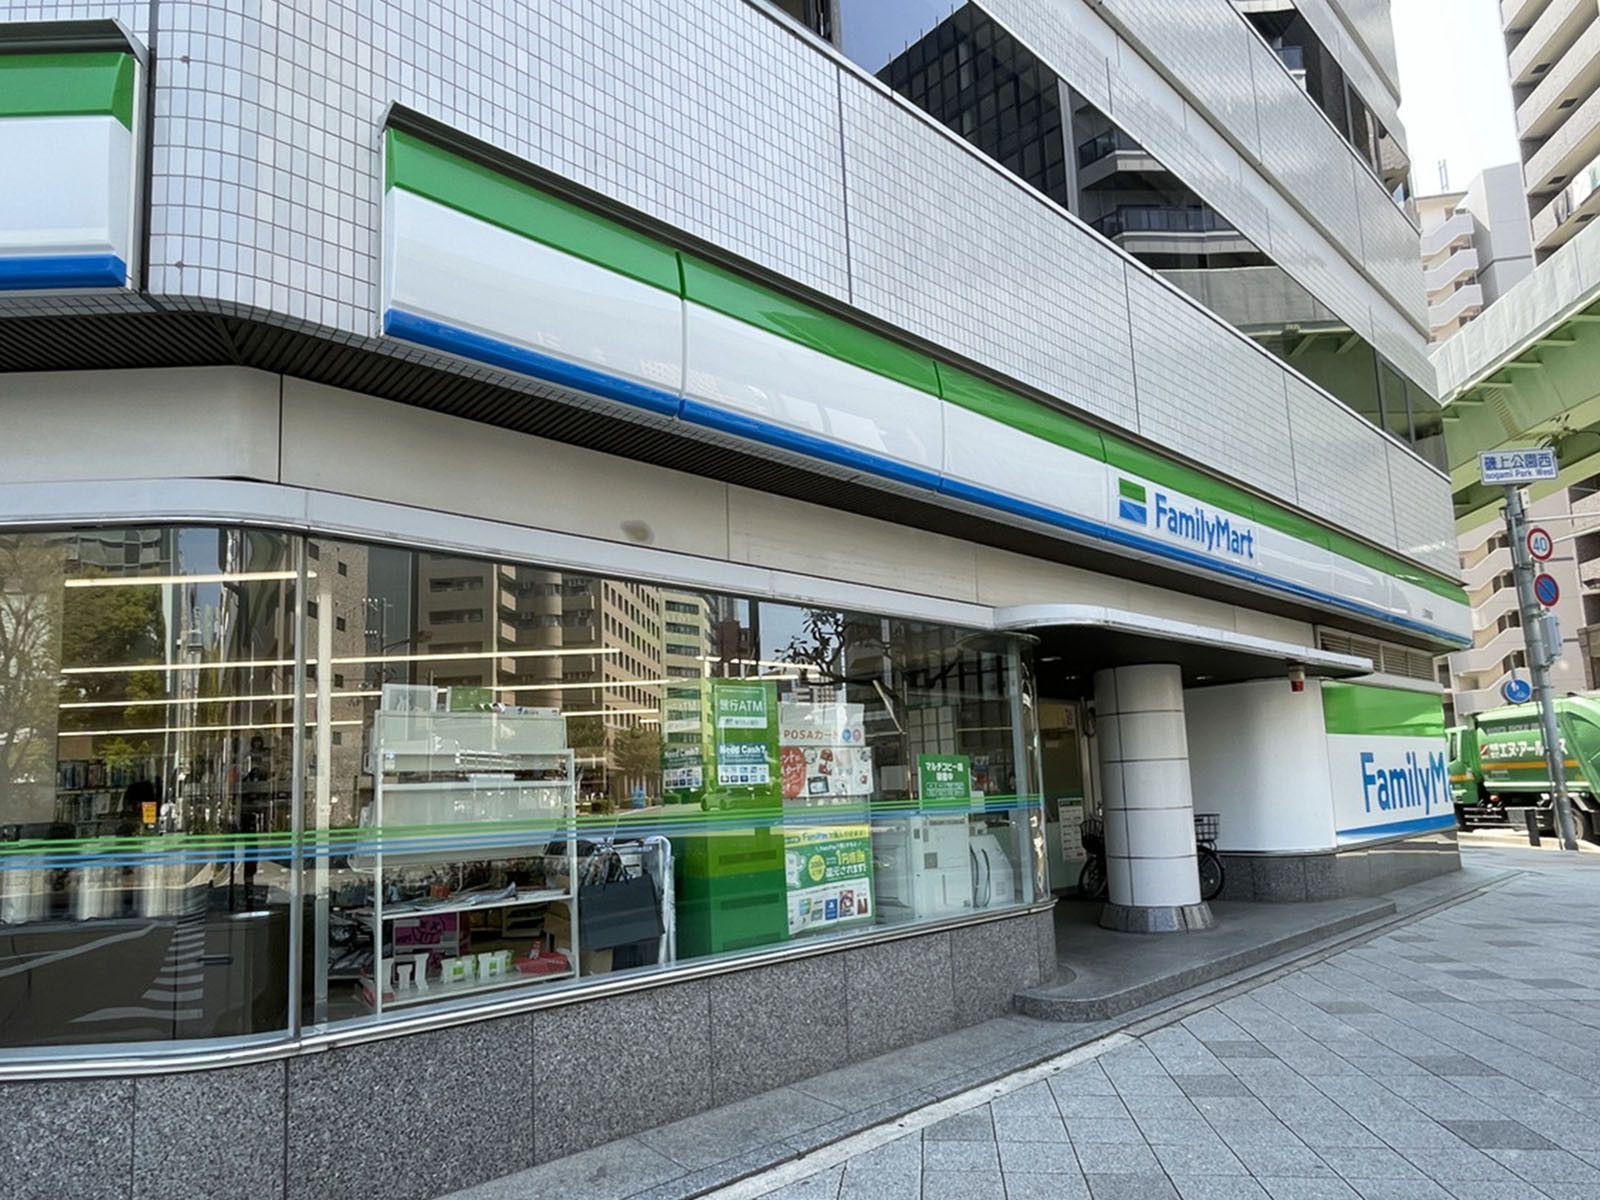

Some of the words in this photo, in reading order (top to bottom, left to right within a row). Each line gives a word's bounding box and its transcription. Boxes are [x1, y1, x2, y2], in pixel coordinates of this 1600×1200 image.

[1484, 453, 1552, 471] 磯上公園西
[1515, 469, 1532, 477] Park
[1536, 468, 1554, 476] West
[1155, 492, 1254, 559] FamilyMart
[1533, 537, 1547, 551] 40
[719, 745, 740, 755] Need
[741, 745, 766, 755] Cash?
